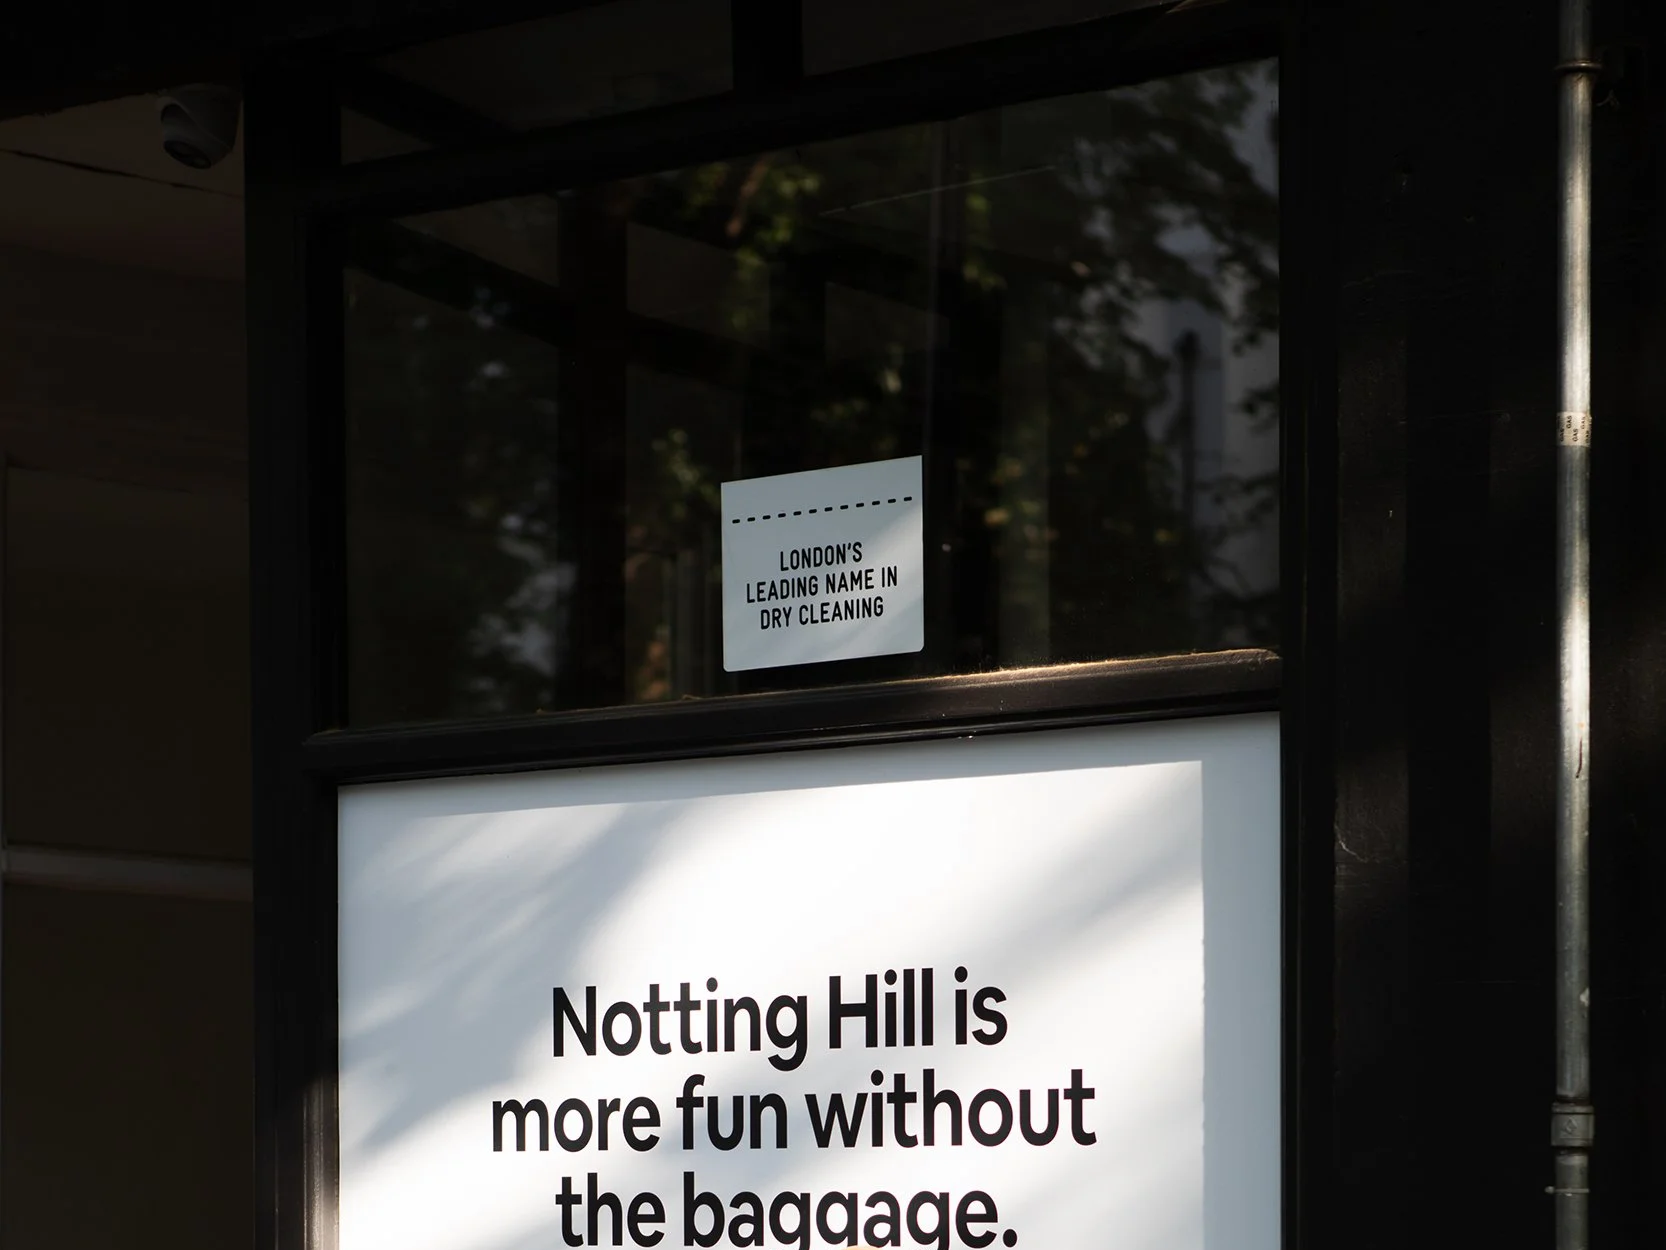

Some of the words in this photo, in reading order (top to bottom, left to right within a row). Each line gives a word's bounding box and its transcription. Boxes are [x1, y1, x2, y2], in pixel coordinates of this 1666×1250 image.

[746, 574, 819, 604] LEADING
[825, 568, 875, 595] NAME
[881, 565, 898, 588] IN
[779, 541, 863, 572] LONDON'S
[760, 606, 793, 631] DRY
[798, 595, 884, 626] CLEANING
[552, 977, 808, 1072] Notting
[829, 967, 934, 1049] Hill
[954, 966, 1008, 1046] is
[492, 1096, 661, 1153] more
[676, 1074, 788, 1151] fun
[804, 1068, 1097, 1149] without
[555, 1172, 666, 1248] the
